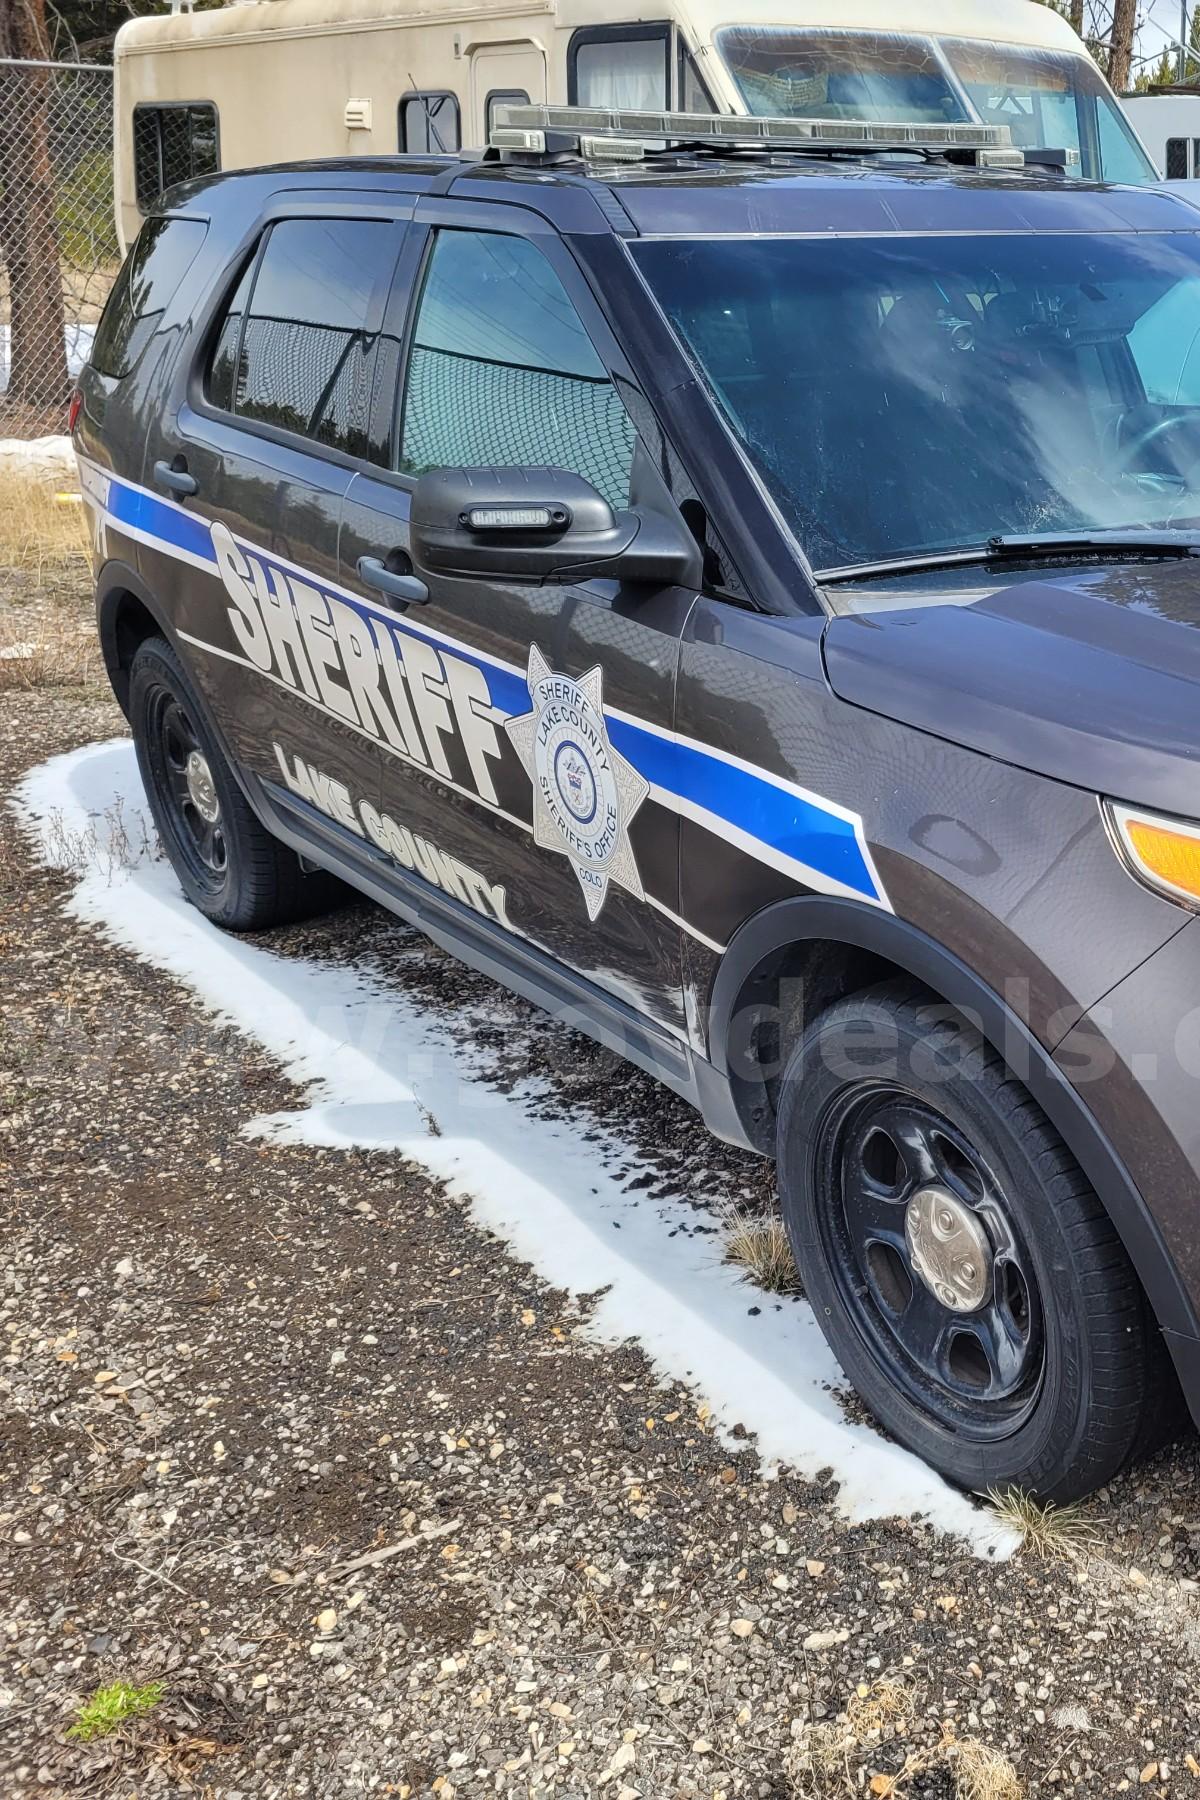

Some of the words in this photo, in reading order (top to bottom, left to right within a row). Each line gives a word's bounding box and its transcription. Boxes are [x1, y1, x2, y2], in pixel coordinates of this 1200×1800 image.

[209, 519, 502, 807] SHERIFF
[538, 682, 590, 714] SHERIFF
[537, 706, 562, 747] LAKE
[560, 706, 611, 772] COUNTY
[272, 741, 366, 839] LAKE
[358, 799, 514, 932] COUNTY
[594, 804, 618, 858] OFFICE
[579, 867, 603, 890] COLO
